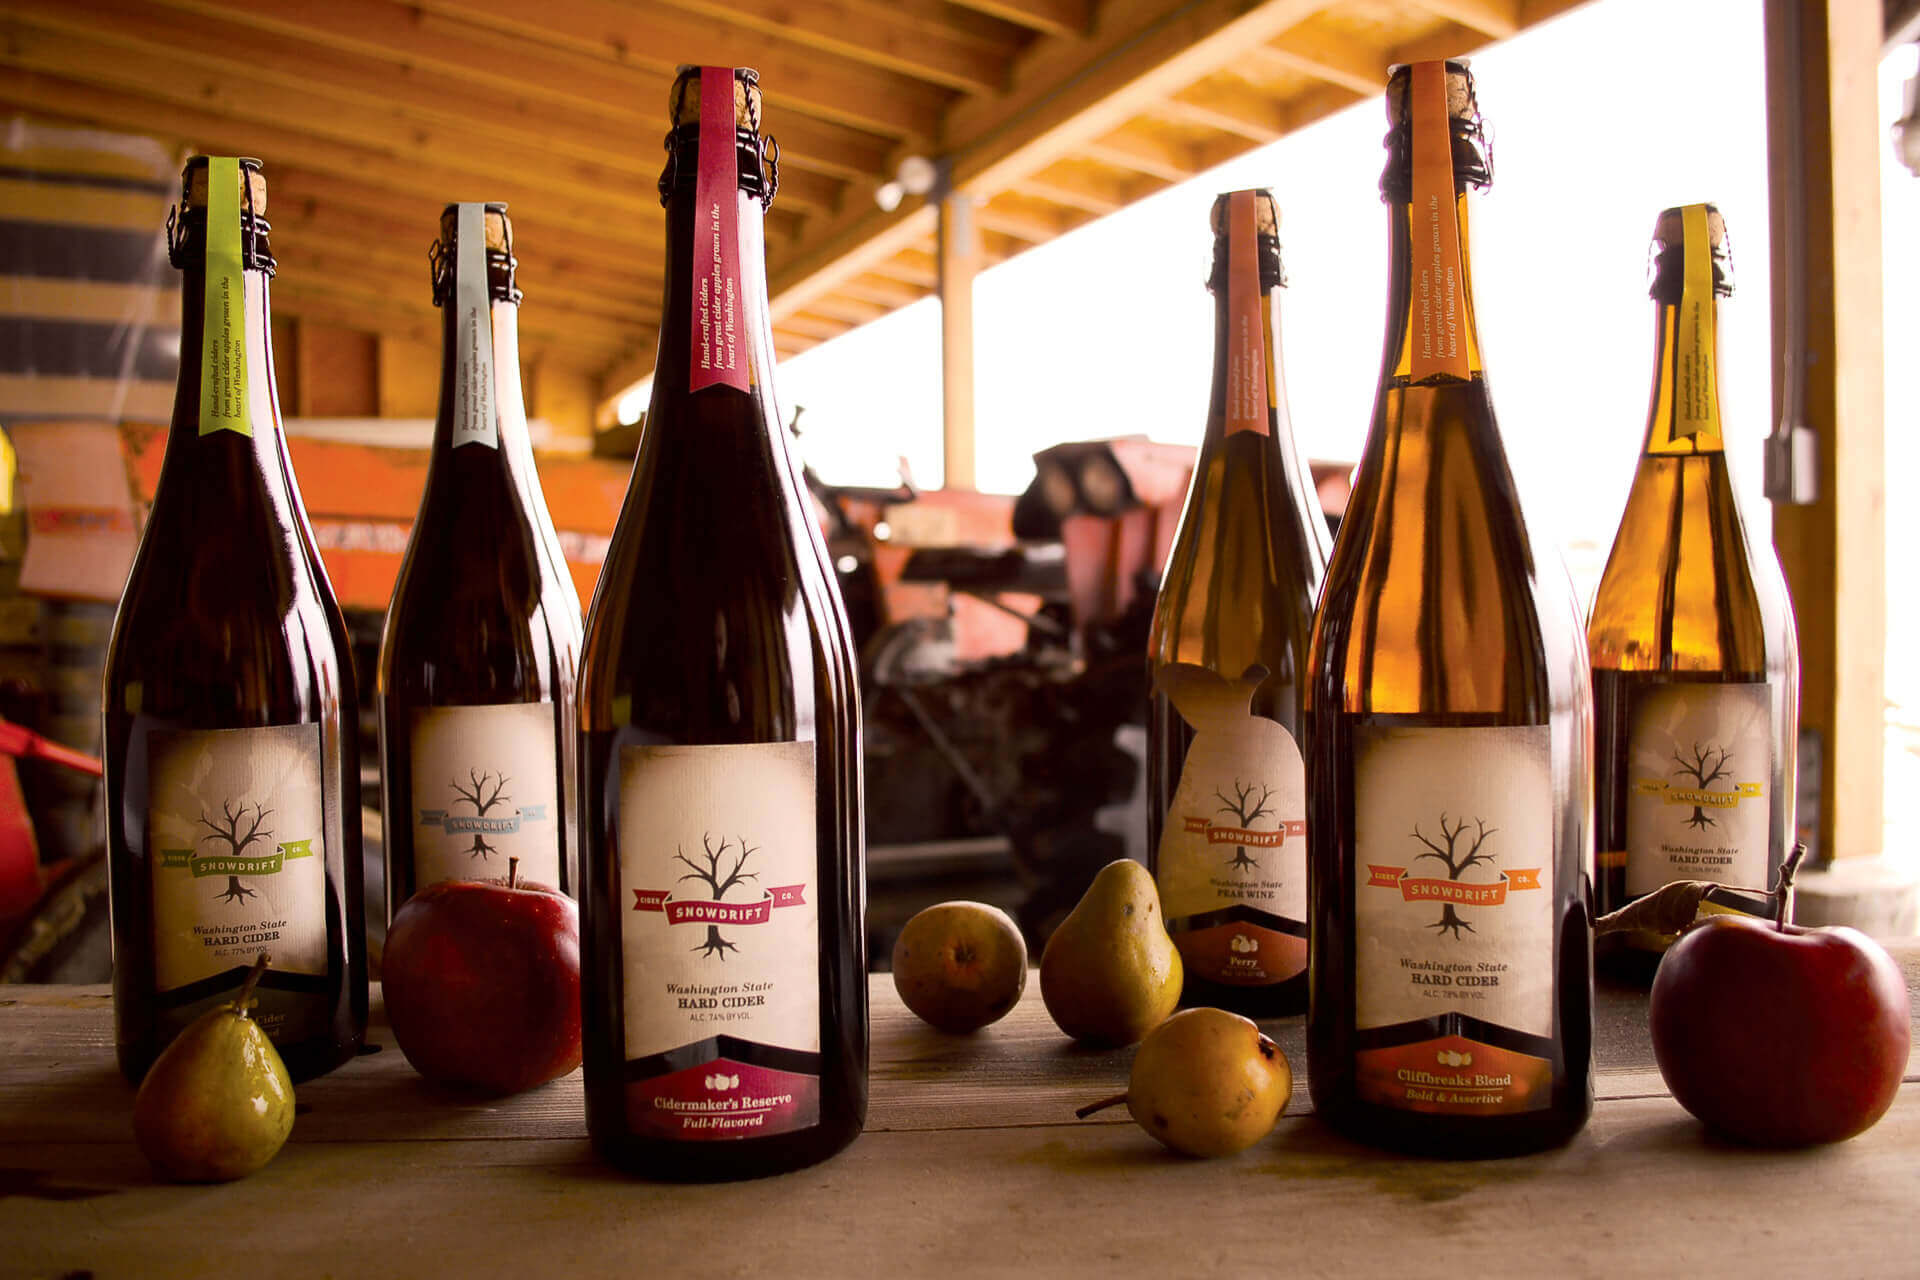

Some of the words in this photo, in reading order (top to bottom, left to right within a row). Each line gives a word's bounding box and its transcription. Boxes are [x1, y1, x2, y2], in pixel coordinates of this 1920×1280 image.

[1429, 195, 1438, 210] the
[710, 204, 719, 219] the
[1431, 212, 1438, 221] in
[712, 222, 719, 231] in
[1432, 224, 1441, 252] grown
[712, 233, 722, 263] grown
[1432, 255, 1442, 284] apples
[220, 277, 229, 289] the
[712, 264, 722, 294] apples
[1420, 270, 1429, 296] ciders
[221, 291, 229, 299] in
[1433, 286, 1442, 309] cider
[1446, 267, 1456, 320] Washington
[713, 296, 721, 319] cider
[726, 278, 735, 331] Washington
[222, 301, 231, 326] grown
[1422, 299, 1431, 359] Hand-crafted
[1434, 311, 1444, 335] great
[1448, 321, 1457, 331] of
[221, 328, 231, 353] apples
[701, 308, 710, 369] Hand-crafted
[714, 322, 723, 345] great
[726, 332, 736, 343] of
[1435, 336, 1445, 358] from
[1448, 332, 1457, 357] heart
[222, 355, 230, 375] cider
[233, 340, 241, 386] Washington
[714, 347, 724, 369] from
[727, 345, 736, 369] heart
[211, 366, 220, 417] Hand-crafted
[223, 377, 231, 397] great
[234, 387, 241, 395] of
[222, 399, 232, 417] from
[1213, 831, 1278, 844] SNOWDRIFT
[1661, 844, 1714, 856] Washington
[1717, 846, 1739, 855] State
[200, 859, 276, 872] SNOWDRIFT
[1669, 855, 1699, 864] HARD
[1701, 855, 1733, 865] CIDER
[1210, 878, 1259, 890] Washington
[1261, 880, 1283, 889] State
[1374, 872, 1396, 881] CIDER
[1517, 875, 1531, 884] CO.
[640, 896, 660, 905] CIDER
[781, 891, 794, 900] CO.
[1217, 889, 1245, 898] PEAR
[1247, 890, 1275, 899] WINE
[1411, 885, 1499, 900] SNOWDRIFT
[675, 906, 763, 921] SNOWDRIFT
[193, 923, 257, 937] Washington
[260, 919, 287, 930] State
[203, 934, 240, 947] HARD
[243, 931, 281, 945] CIDER
[1230, 957, 1258, 968] Perry
[1400, 958, 1473, 973] Washington
[1477, 961, 1508, 973] State
[666, 983, 738, 996] Washington
[741, 981, 774, 992] State
[1411, 973, 1452, 986] HARD
[1455, 975, 1499, 988] CIDER
[678, 997, 718, 1009] HARD
[722, 995, 765, 1008] CIDER
[1397, 1068, 1472, 1087] Cliffbreaks
[1475, 1073, 1512, 1087] Blend
[654, 1096, 739, 1111] Cidermaker's
[741, 1093, 792, 1109] Reserve
[1406, 1088, 1433, 1101] Bold
[1436, 1094, 1446, 1103] &
[1450, 1093, 1504, 1105] Assertive
[683, 1113, 764, 1129] Full-Flavored
